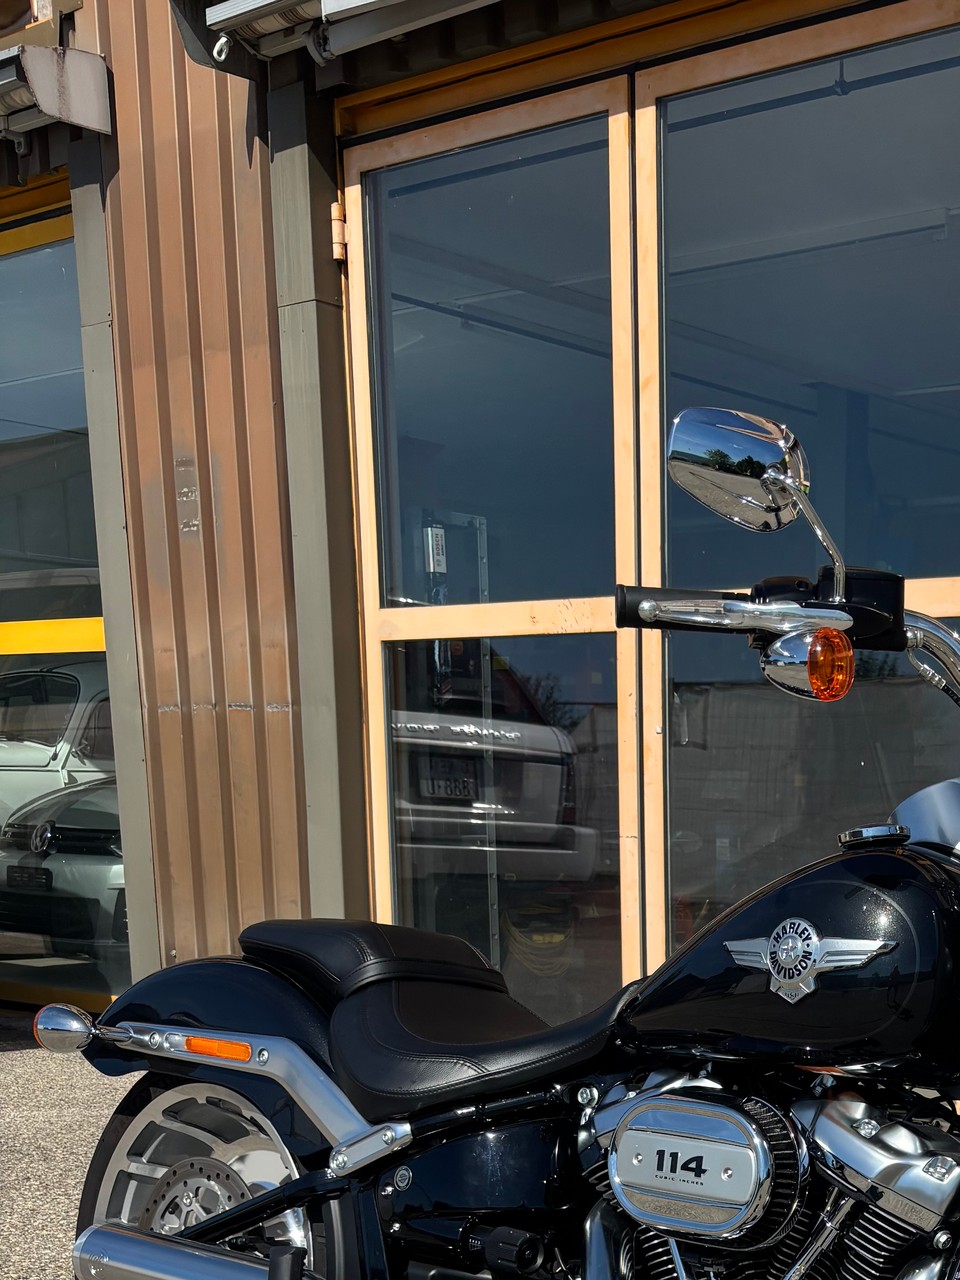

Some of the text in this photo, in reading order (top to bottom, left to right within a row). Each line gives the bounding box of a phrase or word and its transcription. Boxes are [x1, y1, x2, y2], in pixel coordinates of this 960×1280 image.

[773, 921, 813, 944] HARLEY
[769, 950, 813, 980] DAVIDSON
[655, 1149, 709, 1179] 114
[654, 1174, 704, 1186] CUBIC INCHES
